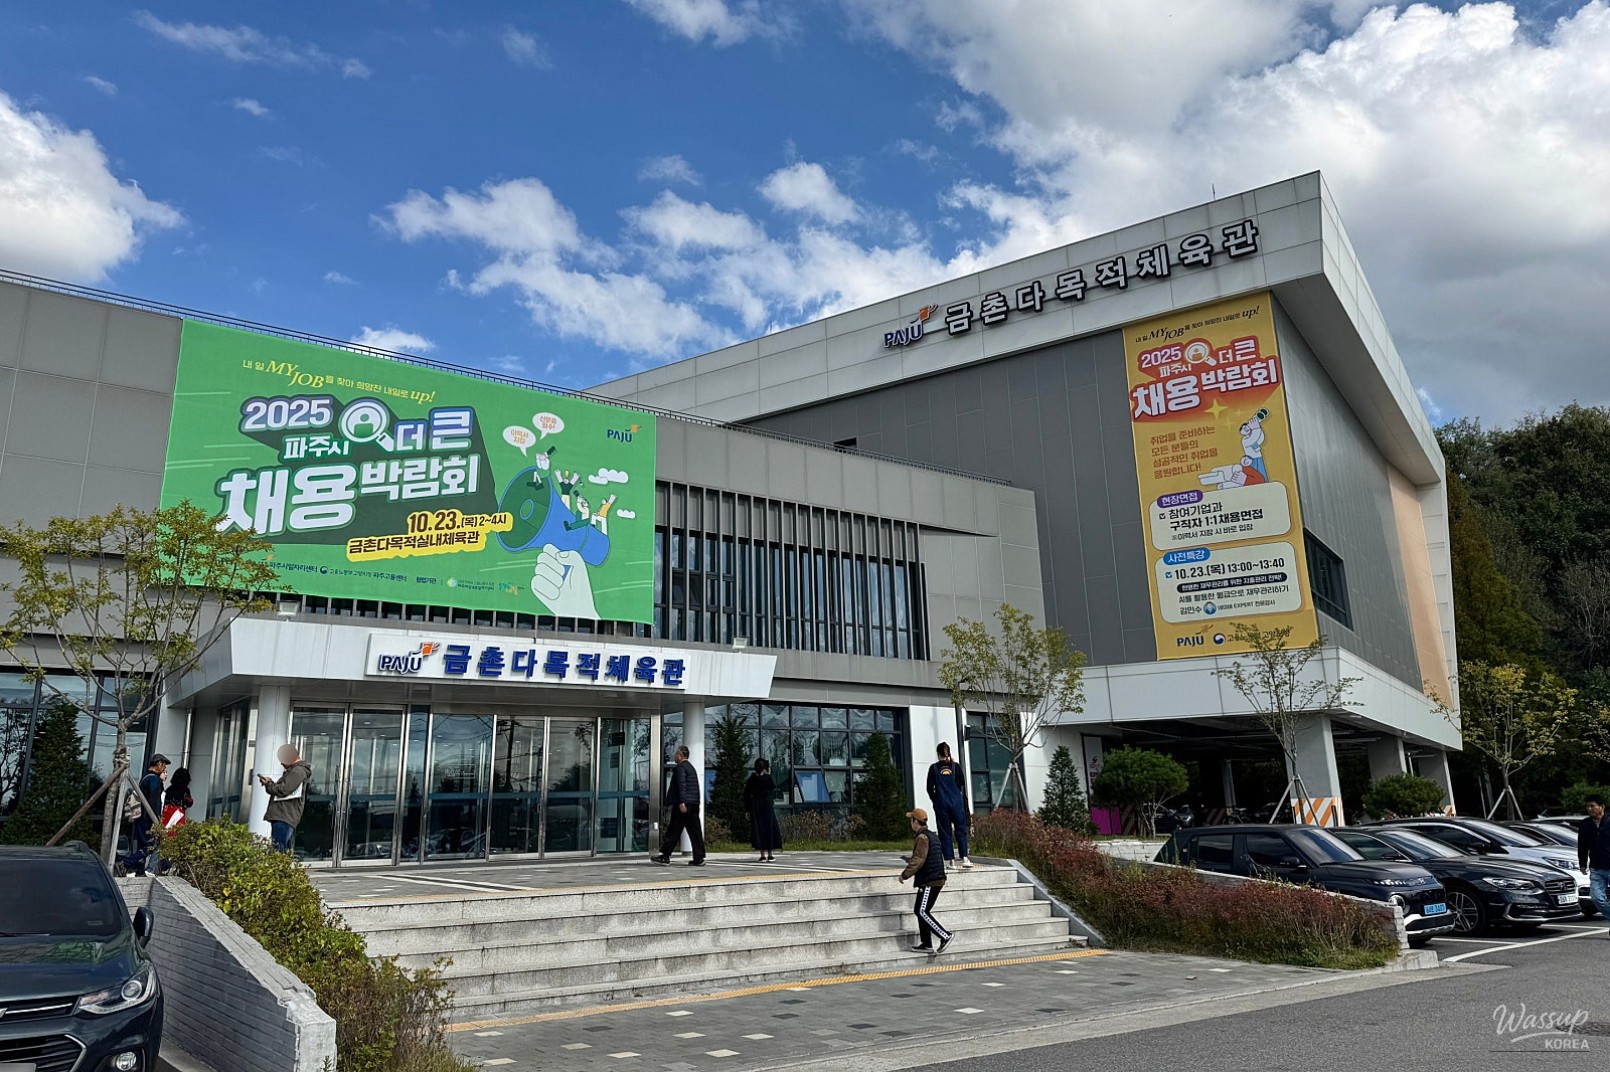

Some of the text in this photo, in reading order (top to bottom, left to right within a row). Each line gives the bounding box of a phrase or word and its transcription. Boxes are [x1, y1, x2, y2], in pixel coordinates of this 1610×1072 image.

[944, 219, 1259, 337] 금촌다목적체육관
[1242, 305, 1260, 319] up!
[883, 318, 924, 349] PAJU
[1141, 346, 1181, 369] 2025
[1159, 363, 1192, 378] 파주시
[266, 360, 299, 376] MY
[336, 377, 354, 388] 찾아
[356, 381, 382, 393] 희망찬
[383, 386, 409, 398] 내일로
[410, 391, 436, 405] up!
[244, 399, 331, 430] 2025
[607, 428, 633, 443] PAJU
[1151, 425, 1215, 445] 취업을 준비하는
[283, 436, 349, 459] 파주시
[1152, 440, 1199, 457] 모든 분들의
[1153, 447, 1218, 468] 성공적인 취업을
[1154, 463, 1201, 479] 응원합니다!
[1161, 492, 1198, 507] 현장면접
[1168, 502, 1223, 520] 참여기업과
[1170, 518, 1202, 531] 구직자
[1239, 523, 1253, 532] 입장
[349, 530, 480, 555] 금촌다목적실내체육관
[1167, 549, 1206, 563] 사전특강
[1228, 558, 1285, 573] 13:00~13:40
[1246, 584, 1289, 596] 재무관리하기
[1176, 635, 1205, 647] PAJU
[379, 644, 686, 685] PAJU 금촌다목적체육관
